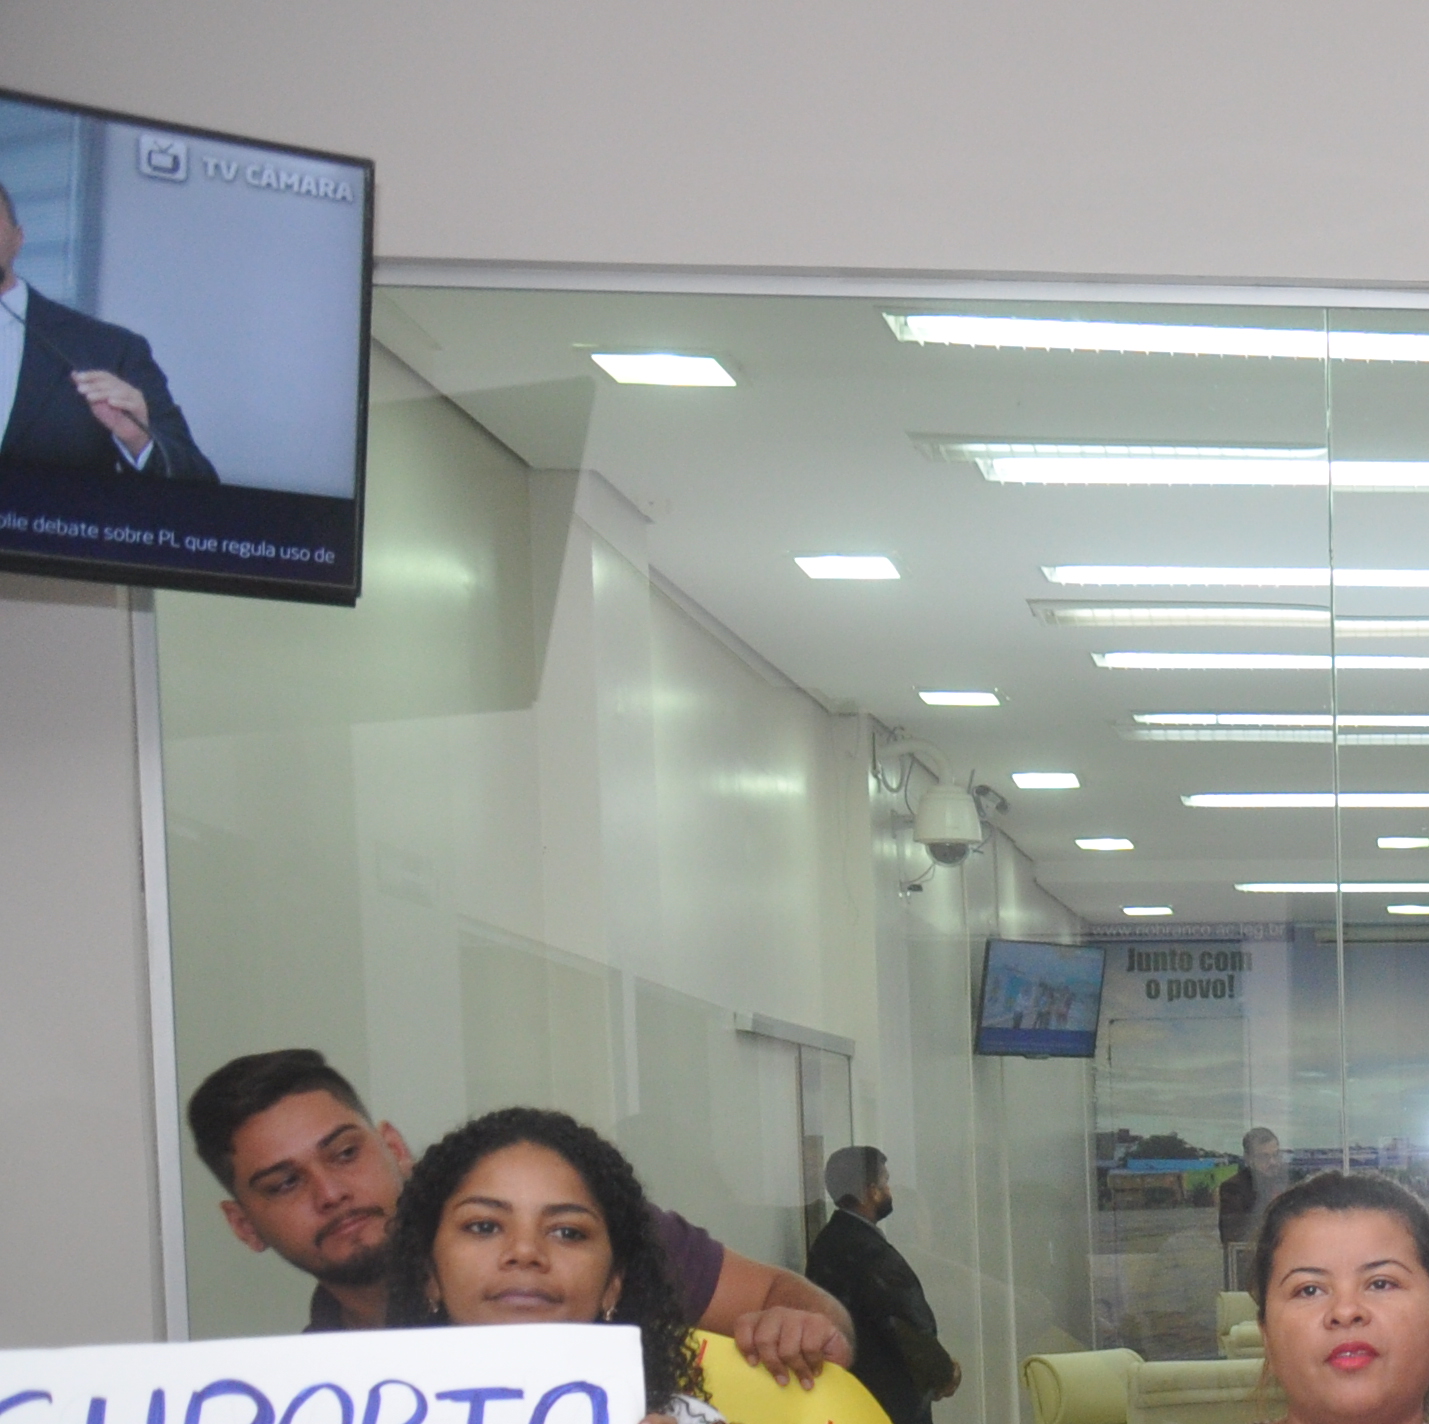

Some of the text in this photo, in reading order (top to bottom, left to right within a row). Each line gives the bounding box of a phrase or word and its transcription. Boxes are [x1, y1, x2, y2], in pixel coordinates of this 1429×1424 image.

[203, 157, 353, 201] TV CÂMARA
[33, 516, 98, 539] debate
[104, 524, 154, 545] sobre
[158, 529, 180, 547] PL
[184, 536, 218, 553] que
[222, 539, 275, 559] regula
[280, 547, 310, 561] uso
[314, 549, 335, 563] de
[1126, 948, 1252, 972] Junto com
[1145, 974, 1235, 1001] o povo!
